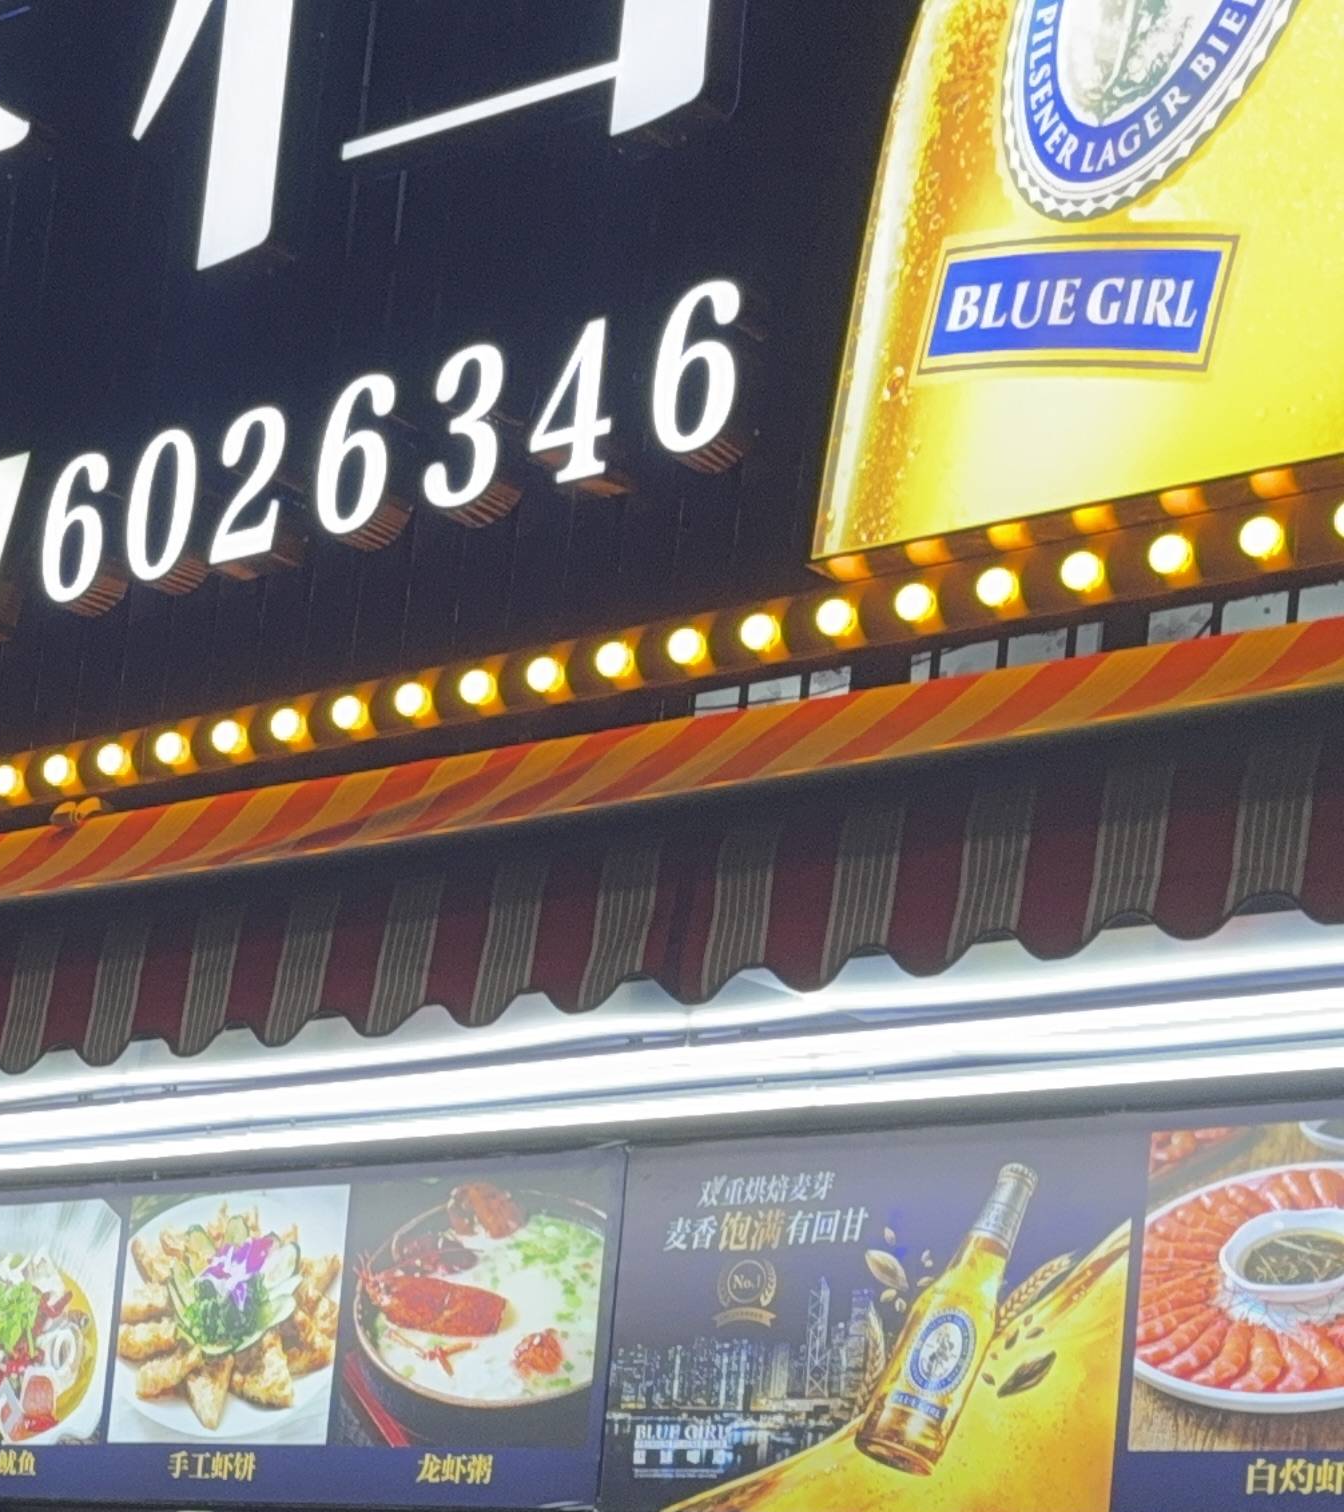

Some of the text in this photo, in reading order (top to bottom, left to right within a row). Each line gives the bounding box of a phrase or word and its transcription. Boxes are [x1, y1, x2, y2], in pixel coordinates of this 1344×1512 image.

[1080, 86, 1191, 174] LAGER
[945, 276, 1199, 332] BLUE GIRL
[41, 280, 741, 603] 6026346
[696, 1170, 836, 1208] 双重烘焙麦芽
[664, 1206, 869, 1252] 麦香饱满有回甘
[167, 1449, 257, 1482] 手工虾饼
[416, 1453, 493, 1484] 龙虾粥
